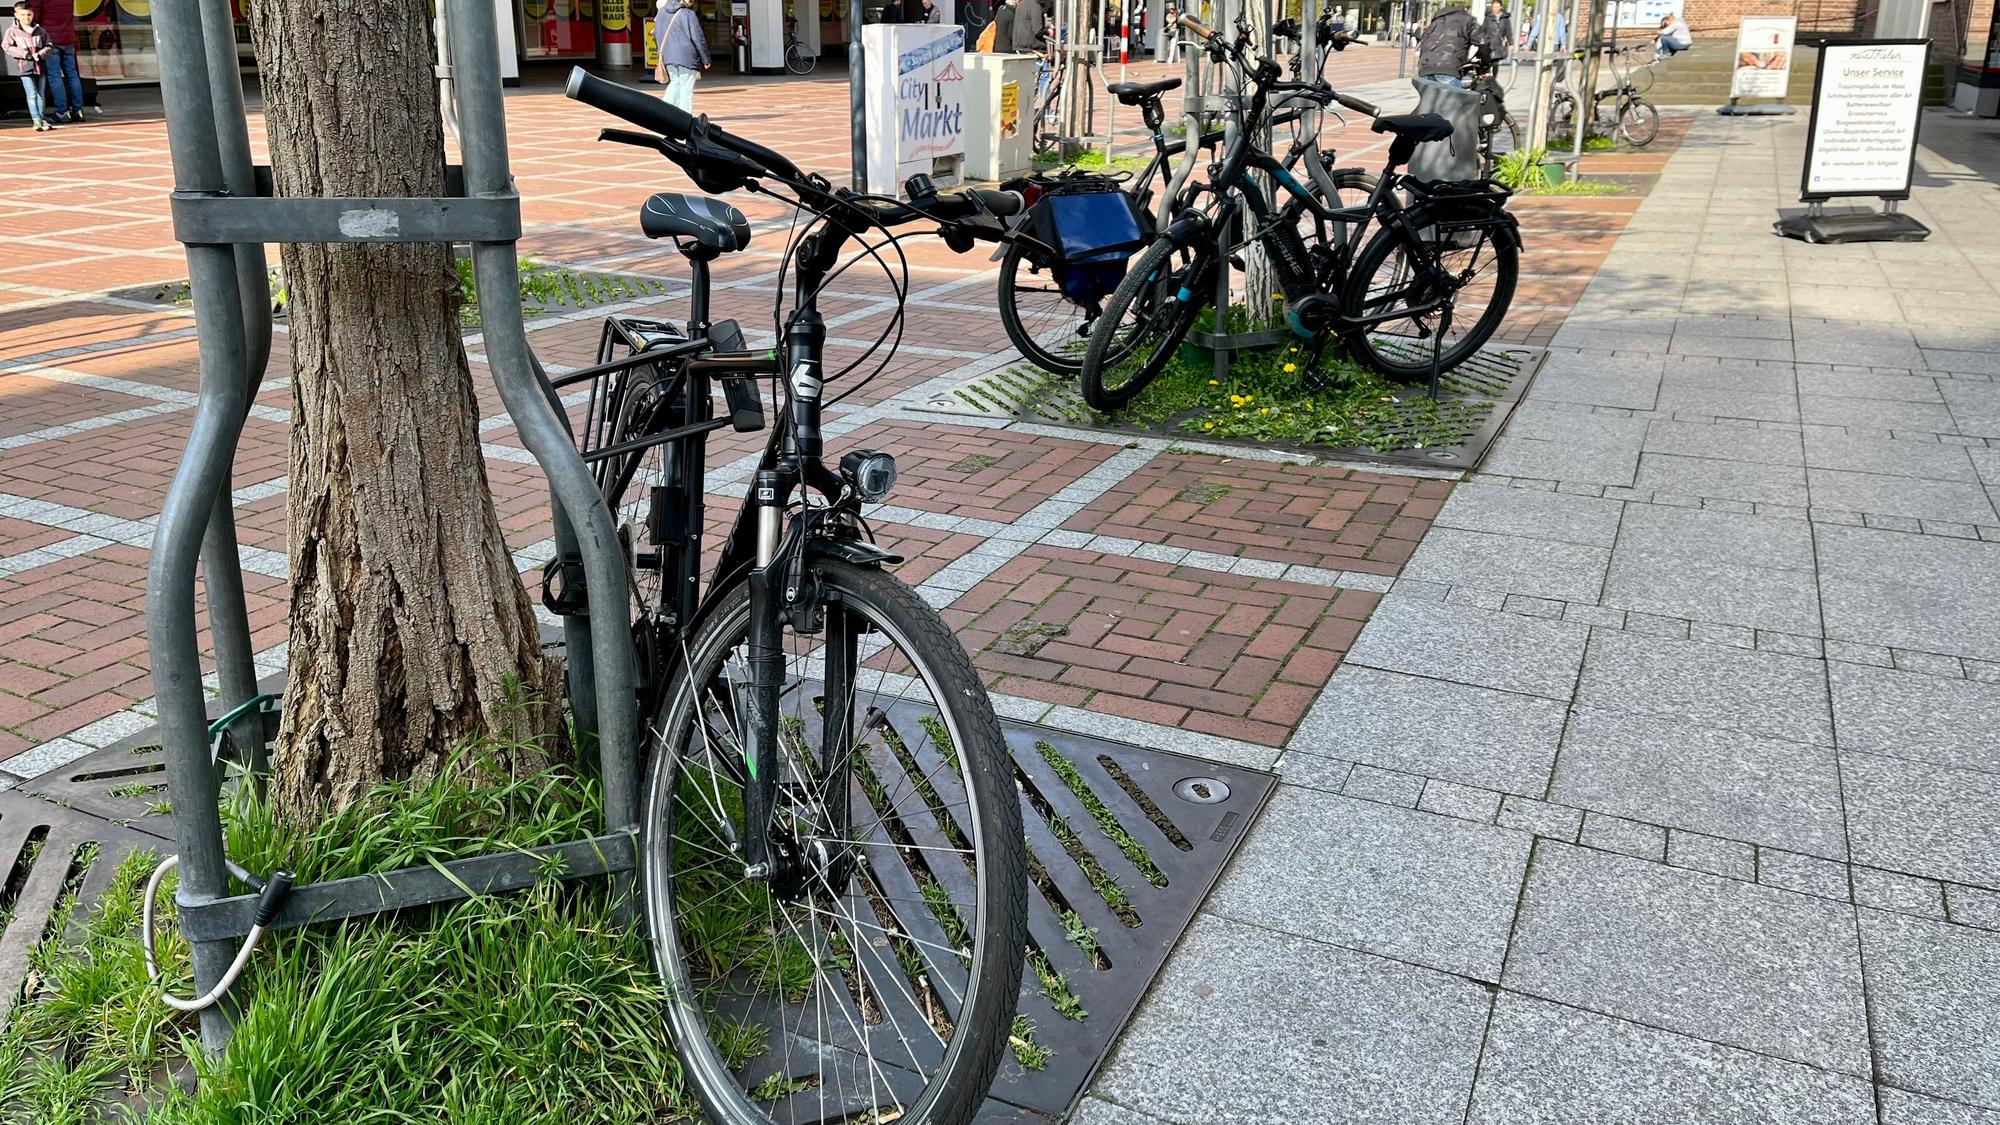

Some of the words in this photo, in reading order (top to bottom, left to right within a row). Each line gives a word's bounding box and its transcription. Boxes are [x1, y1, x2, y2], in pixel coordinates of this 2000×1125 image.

[602, 5, 625, 13] MUSS
[1843, 67, 1870, 77] Unser
[1873, 67, 1905, 77] Service
[901, 78, 925, 101] City
[901, 102, 963, 142] Markt
